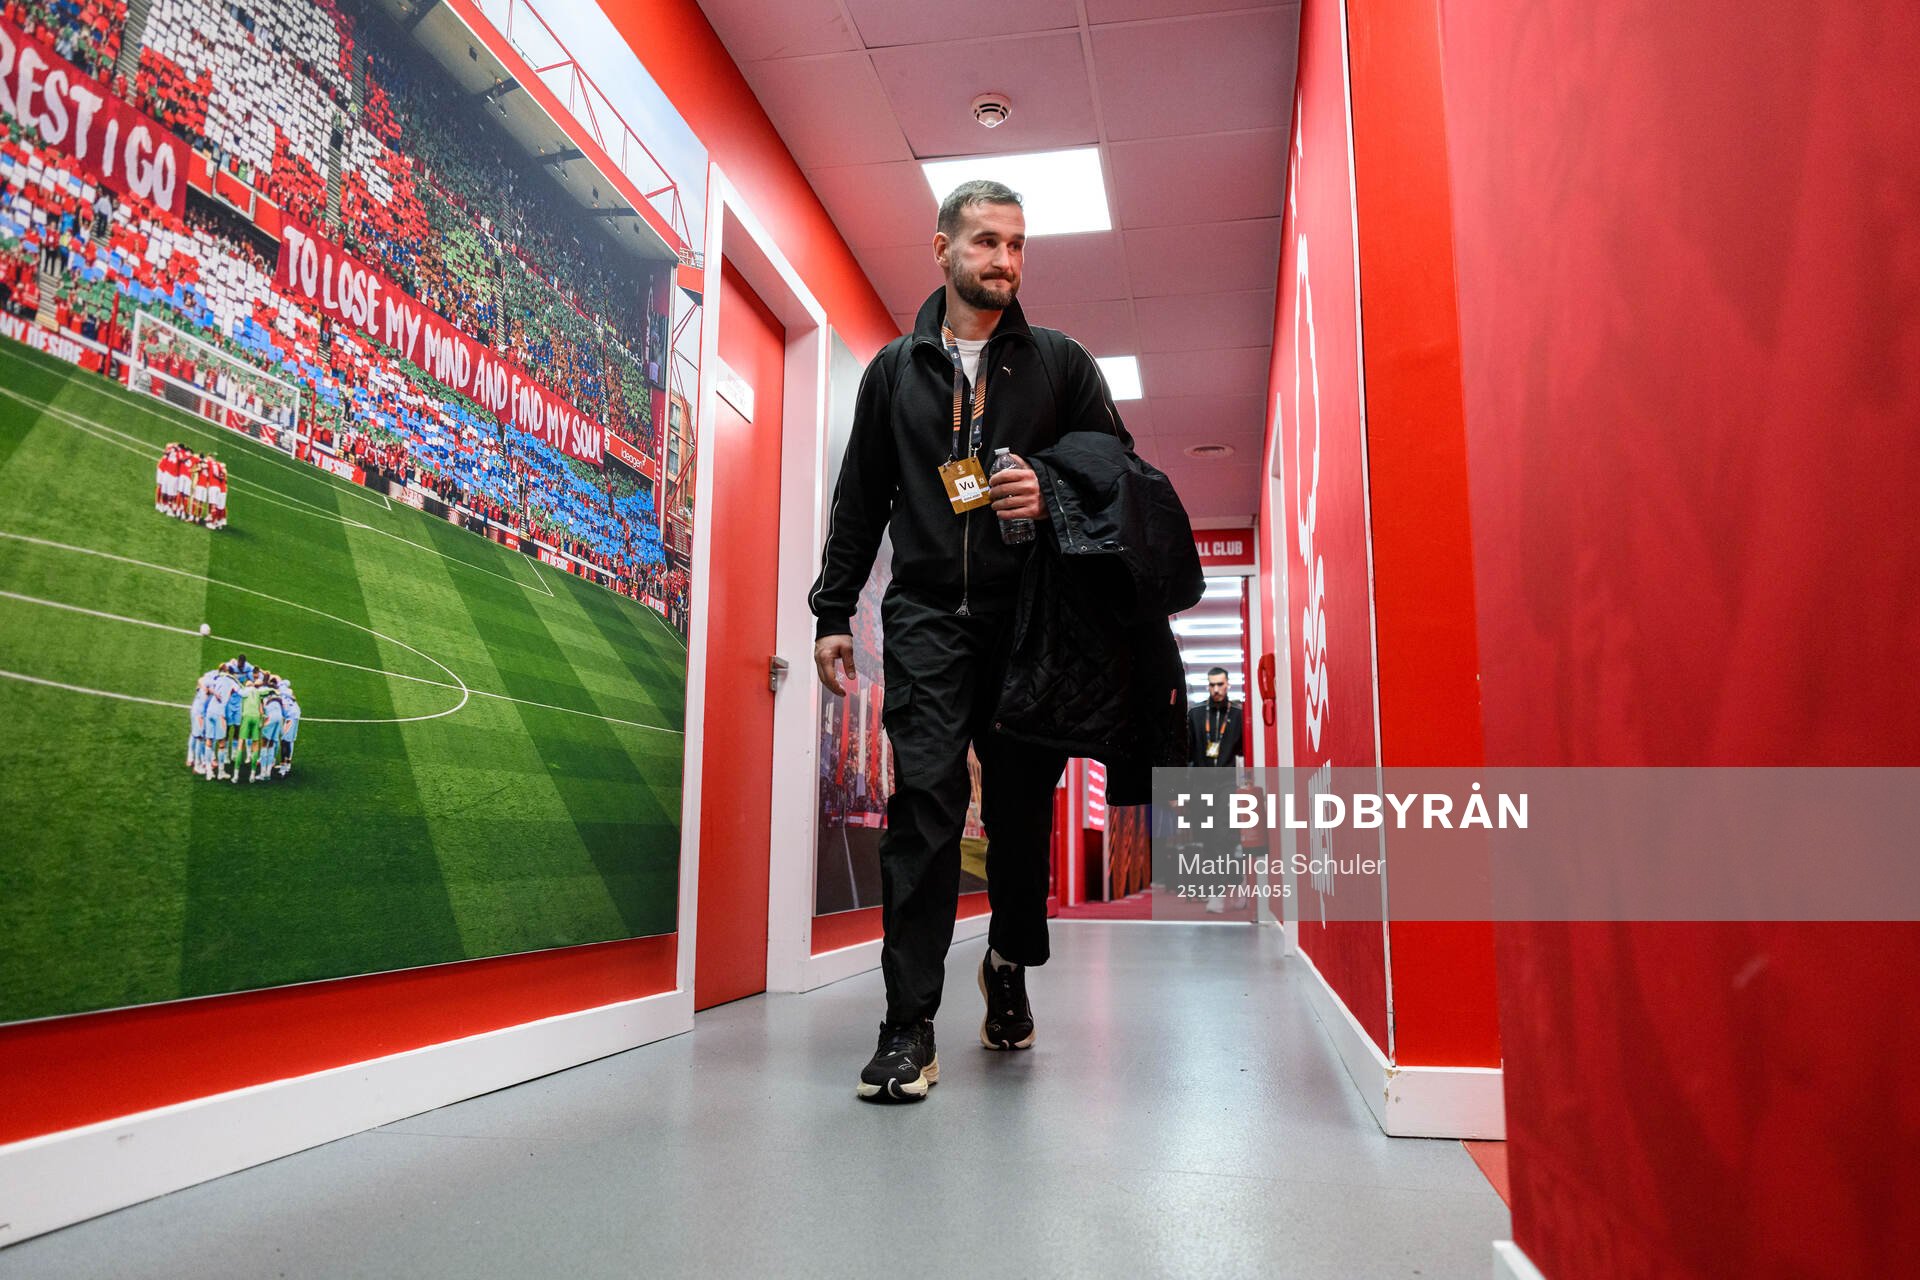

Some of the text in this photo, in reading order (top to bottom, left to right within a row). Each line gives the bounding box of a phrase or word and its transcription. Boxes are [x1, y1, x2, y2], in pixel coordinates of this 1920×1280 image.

[102, 119, 119, 178] I
[124, 125, 177, 212] GO
[283, 225, 319, 299] TO
[322, 253, 383, 336] LOSE
[385, 296, 422, 363] MY
[424, 323, 471, 390] MIND
[472, 352, 508, 413] AND
[511, 374, 544, 434] FIND
[546, 402, 571, 451] MY
[571, 414, 604, 465] SOUL
[959, 480, 975, 491] Vu
[1195, 540, 1244, 557] LL CLUB
